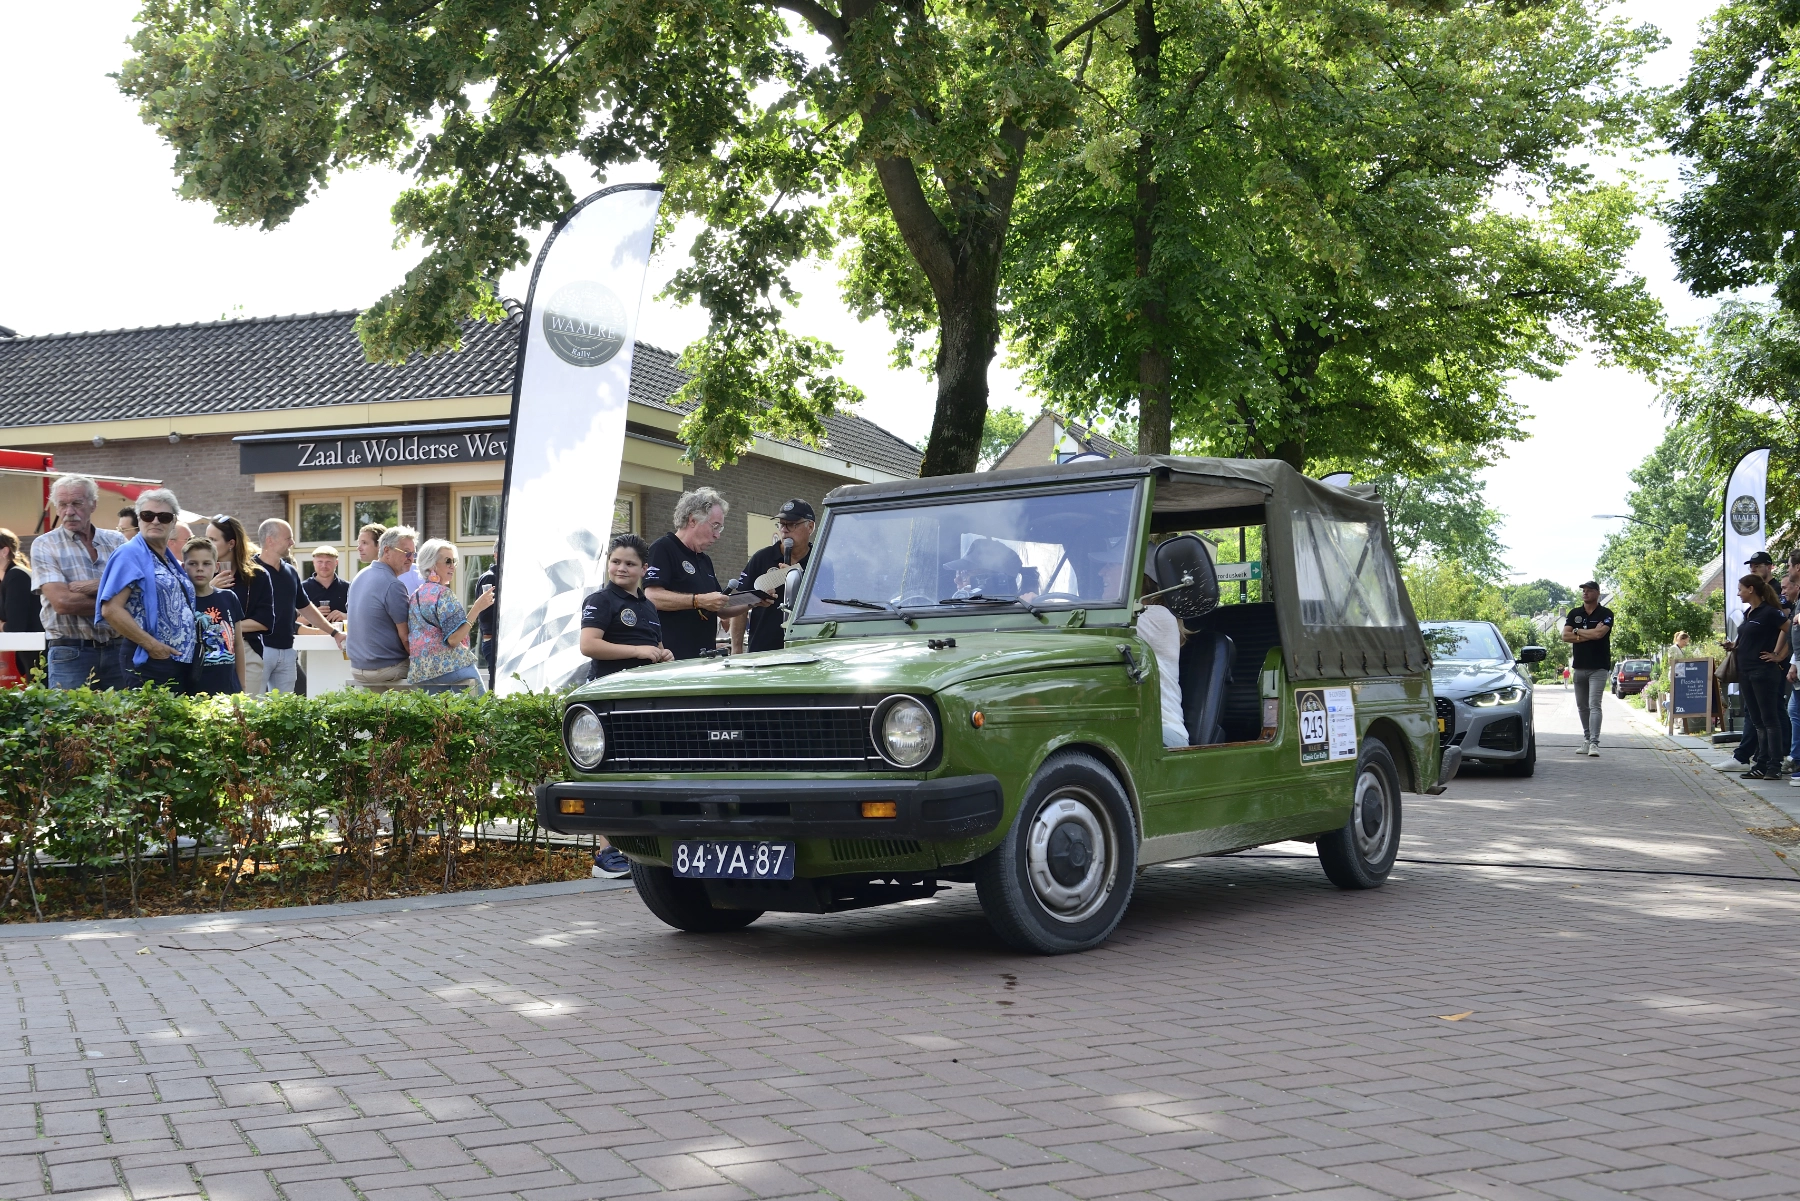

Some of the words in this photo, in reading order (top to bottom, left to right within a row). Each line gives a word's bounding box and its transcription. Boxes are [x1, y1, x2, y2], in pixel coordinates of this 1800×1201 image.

[552, 316, 616, 339] WAALRE
[571, 348, 591, 358] Rally
[298, 441, 343, 467] Zaal
[347, 449, 362, 464] de
[361, 436, 459, 463] Wolderse
[710, 731, 739, 740] DAF
[1303, 715, 1324, 739] 243
